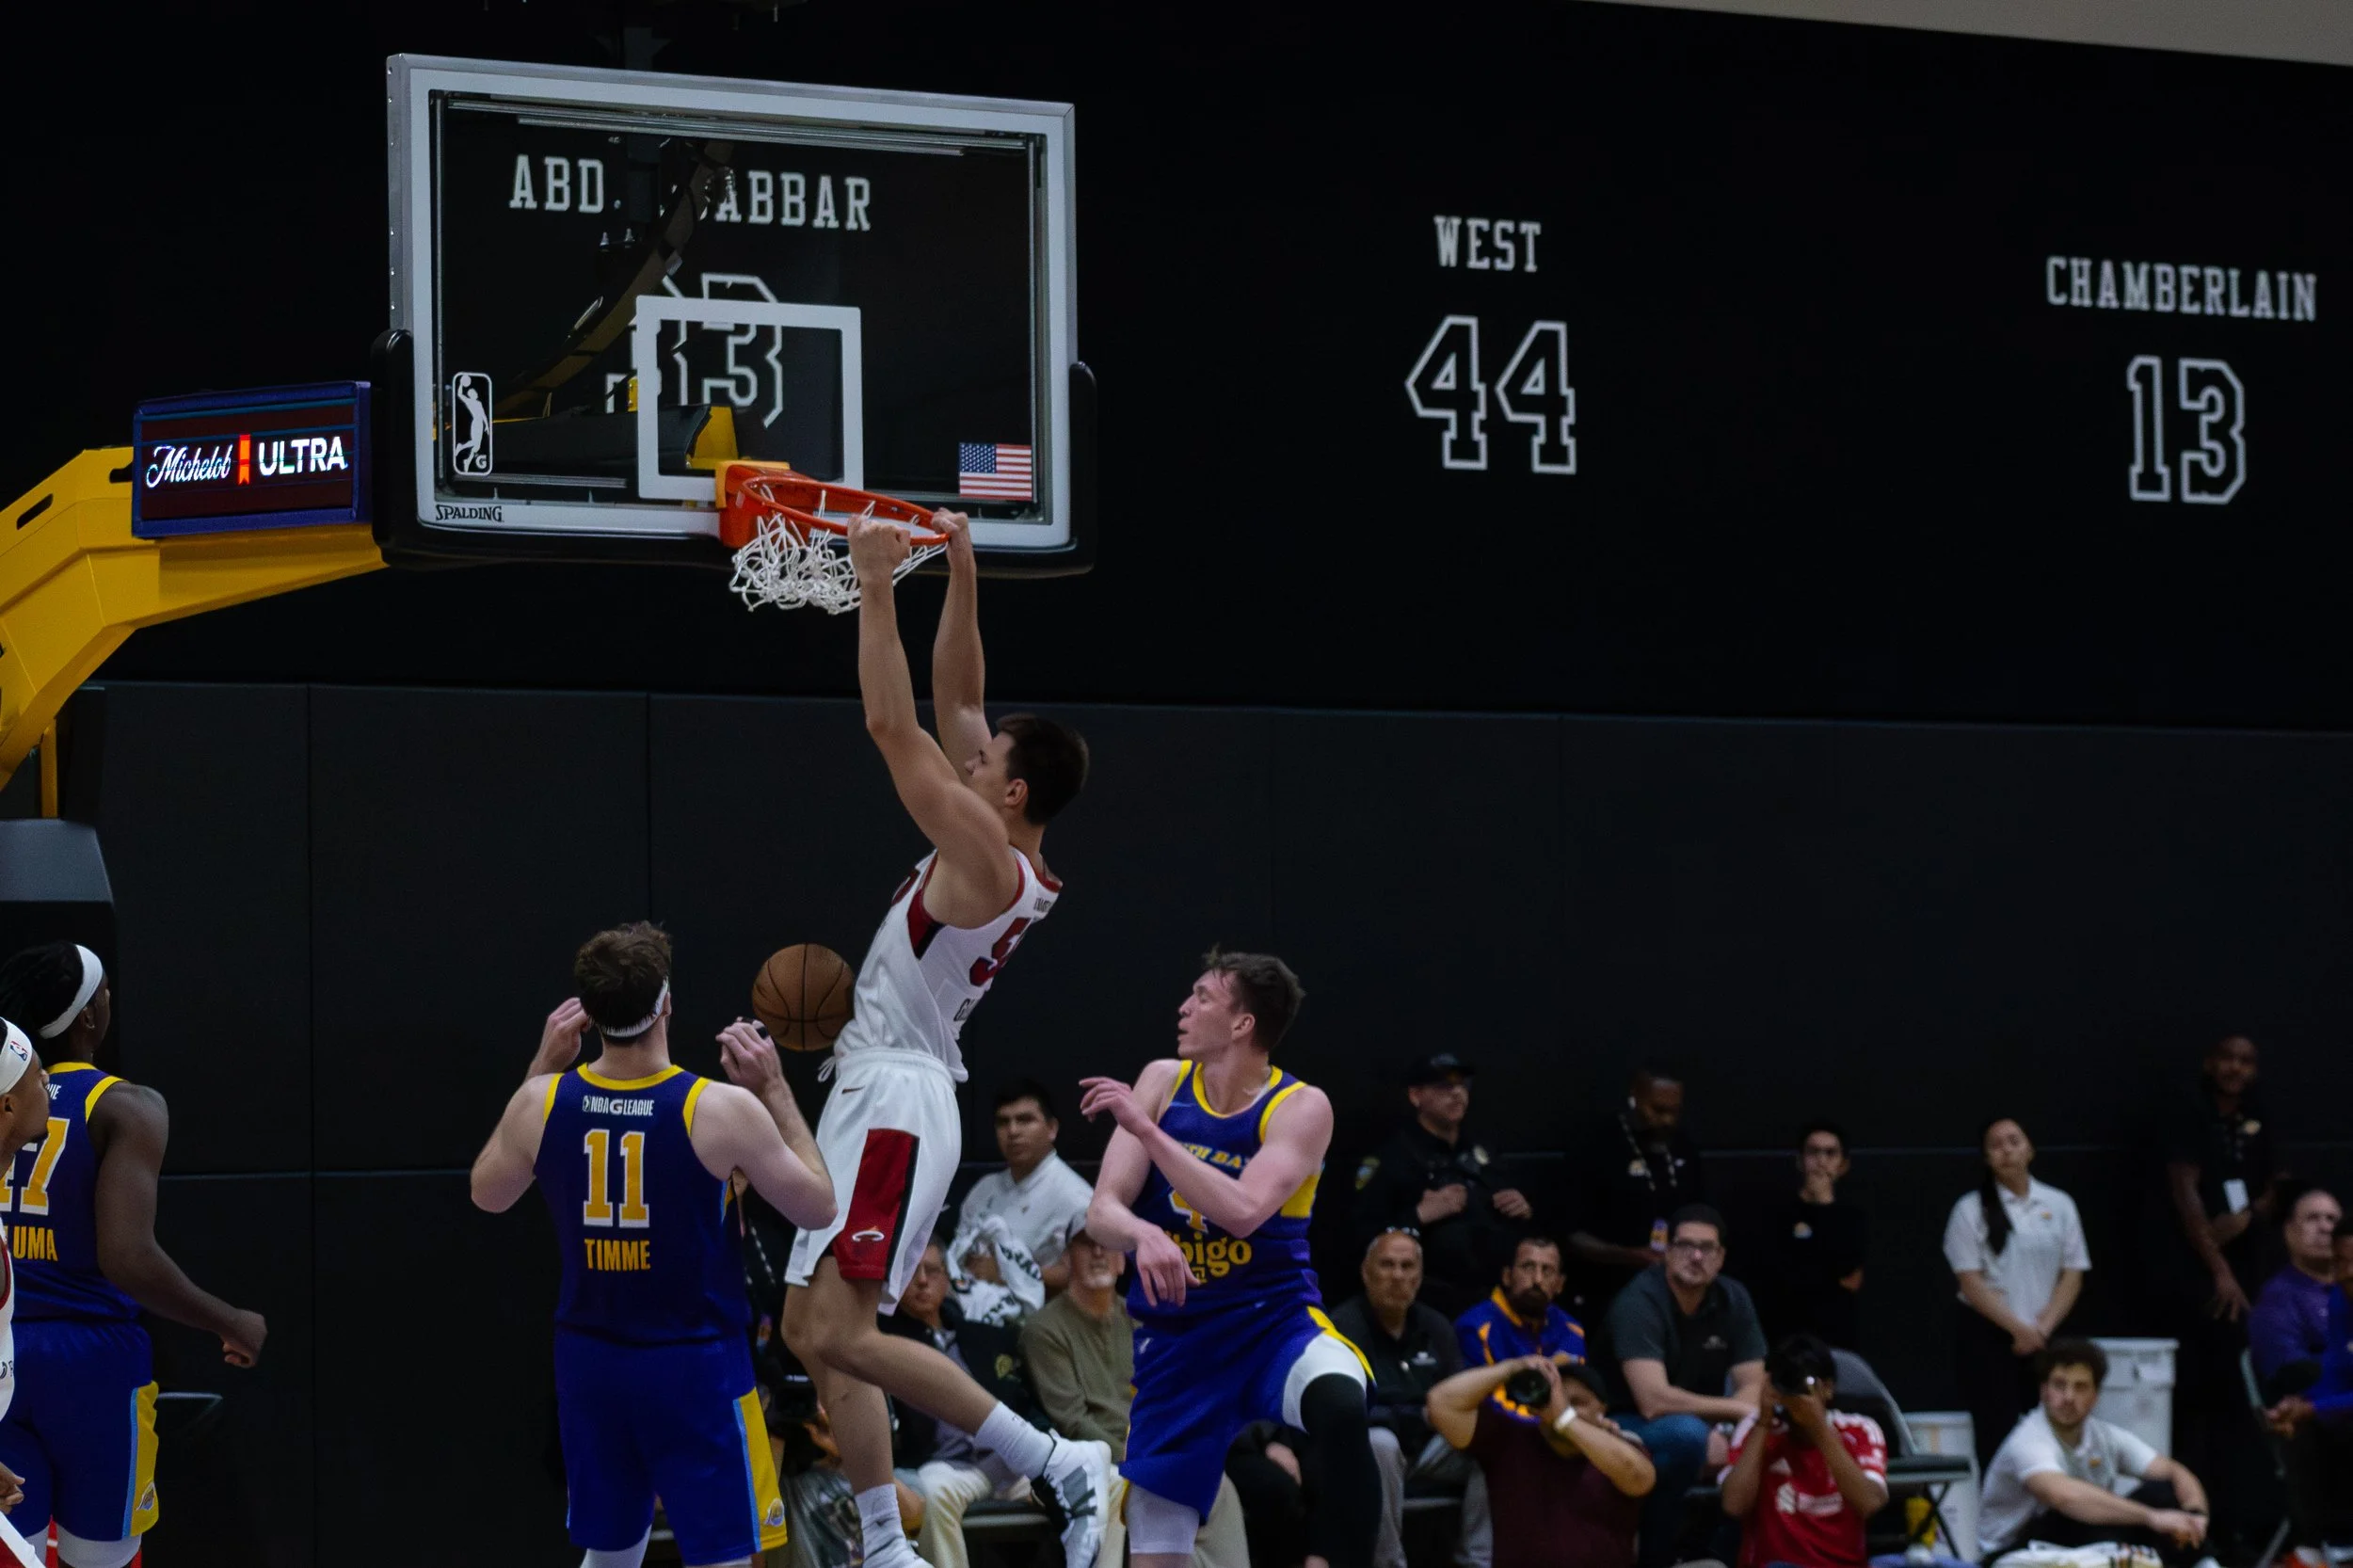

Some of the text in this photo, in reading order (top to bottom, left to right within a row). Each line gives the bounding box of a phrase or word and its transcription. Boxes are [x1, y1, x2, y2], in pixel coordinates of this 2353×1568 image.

[1433, 215, 1542, 273] WEST
[2046, 255, 2317, 322] CHAMBERLAIN
[1405, 313, 1577, 475] 44
[2126, 354, 2247, 505] 13
[146, 436, 349, 488] Michelob ULTRA
[435, 504, 504, 522] SPALDING
[583, 1128, 650, 1229] 11
[4, 1225, 59, 1262] UMA
[584, 1238, 652, 1272] TIMME
